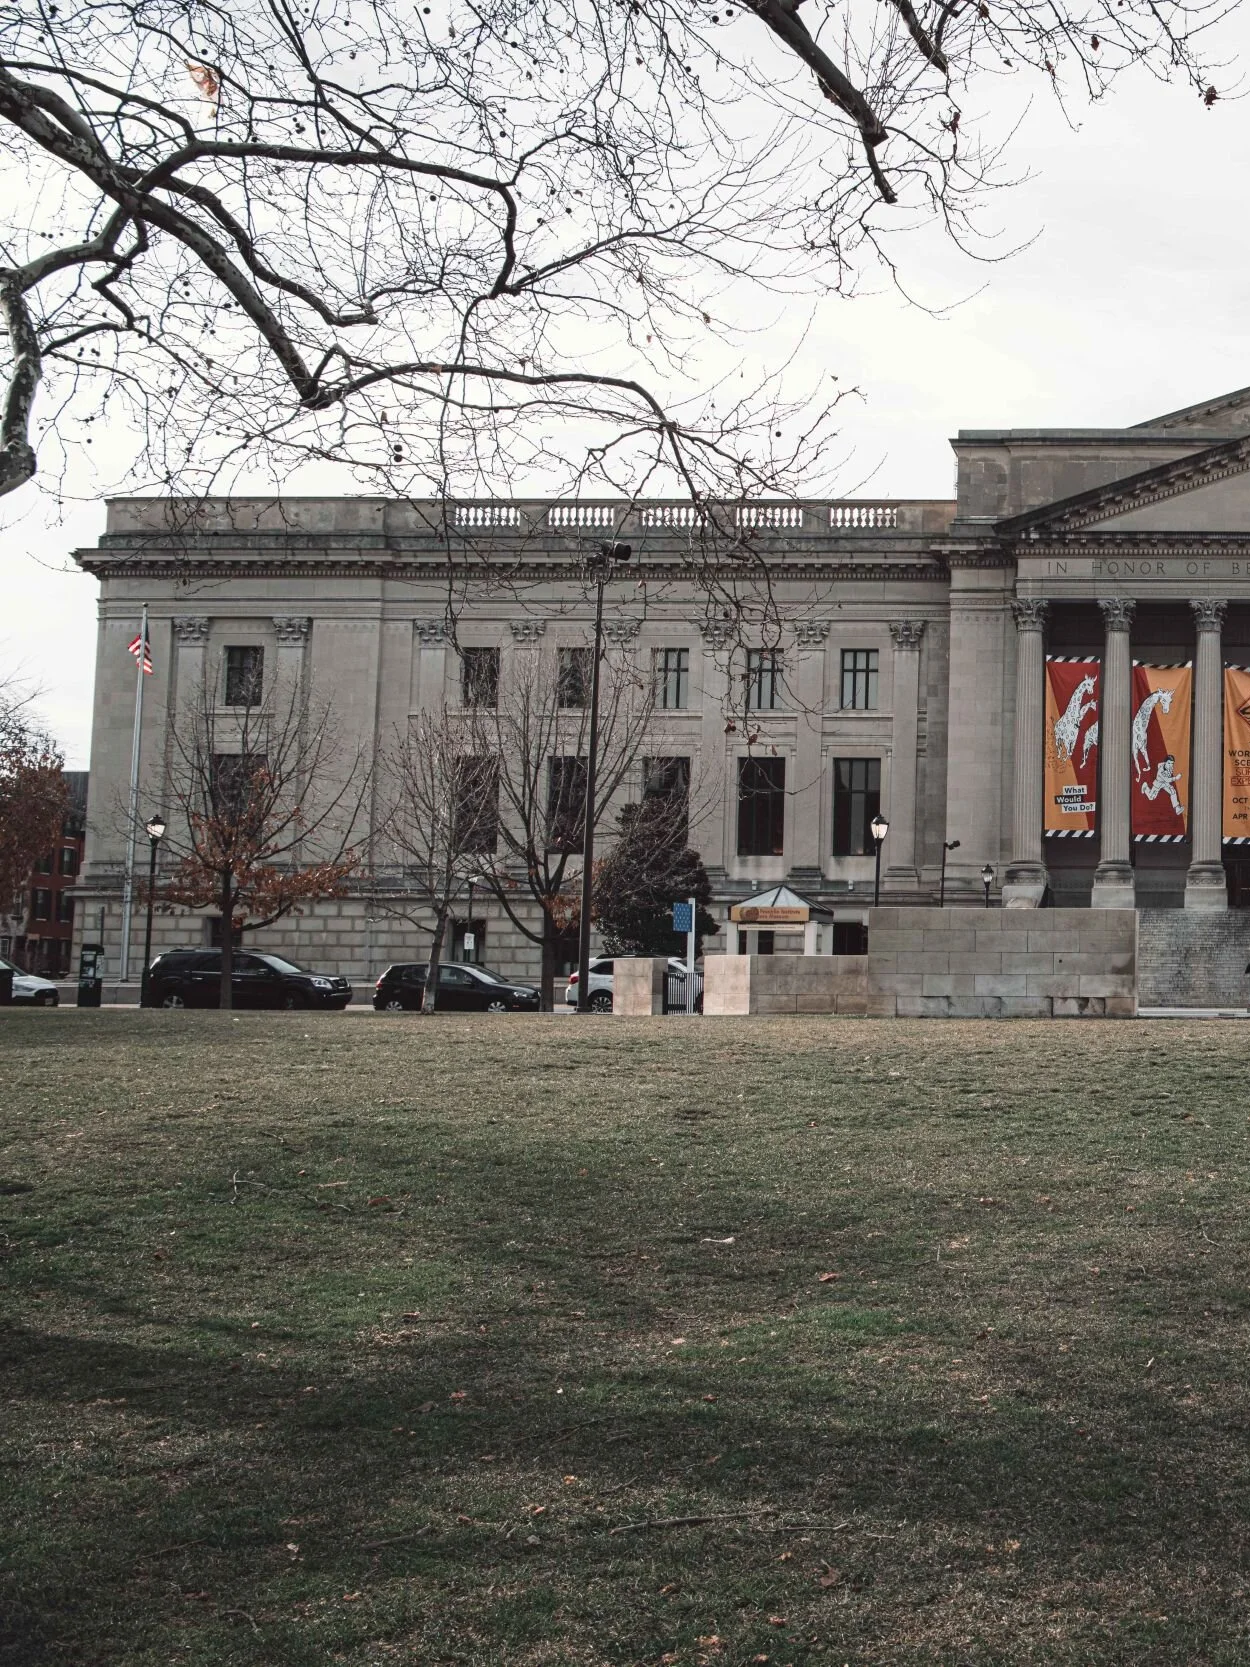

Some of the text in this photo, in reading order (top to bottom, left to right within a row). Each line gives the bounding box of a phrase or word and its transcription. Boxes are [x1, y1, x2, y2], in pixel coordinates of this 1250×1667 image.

[1047, 561, 1068, 575] IN
[1092, 561, 1166, 576] HONOR
[1186, 561, 1211, 576] OF
[1064, 786, 1085, 794] What
[1056, 795, 1082, 804] Would
[1063, 803, 1094, 812] You Do?
